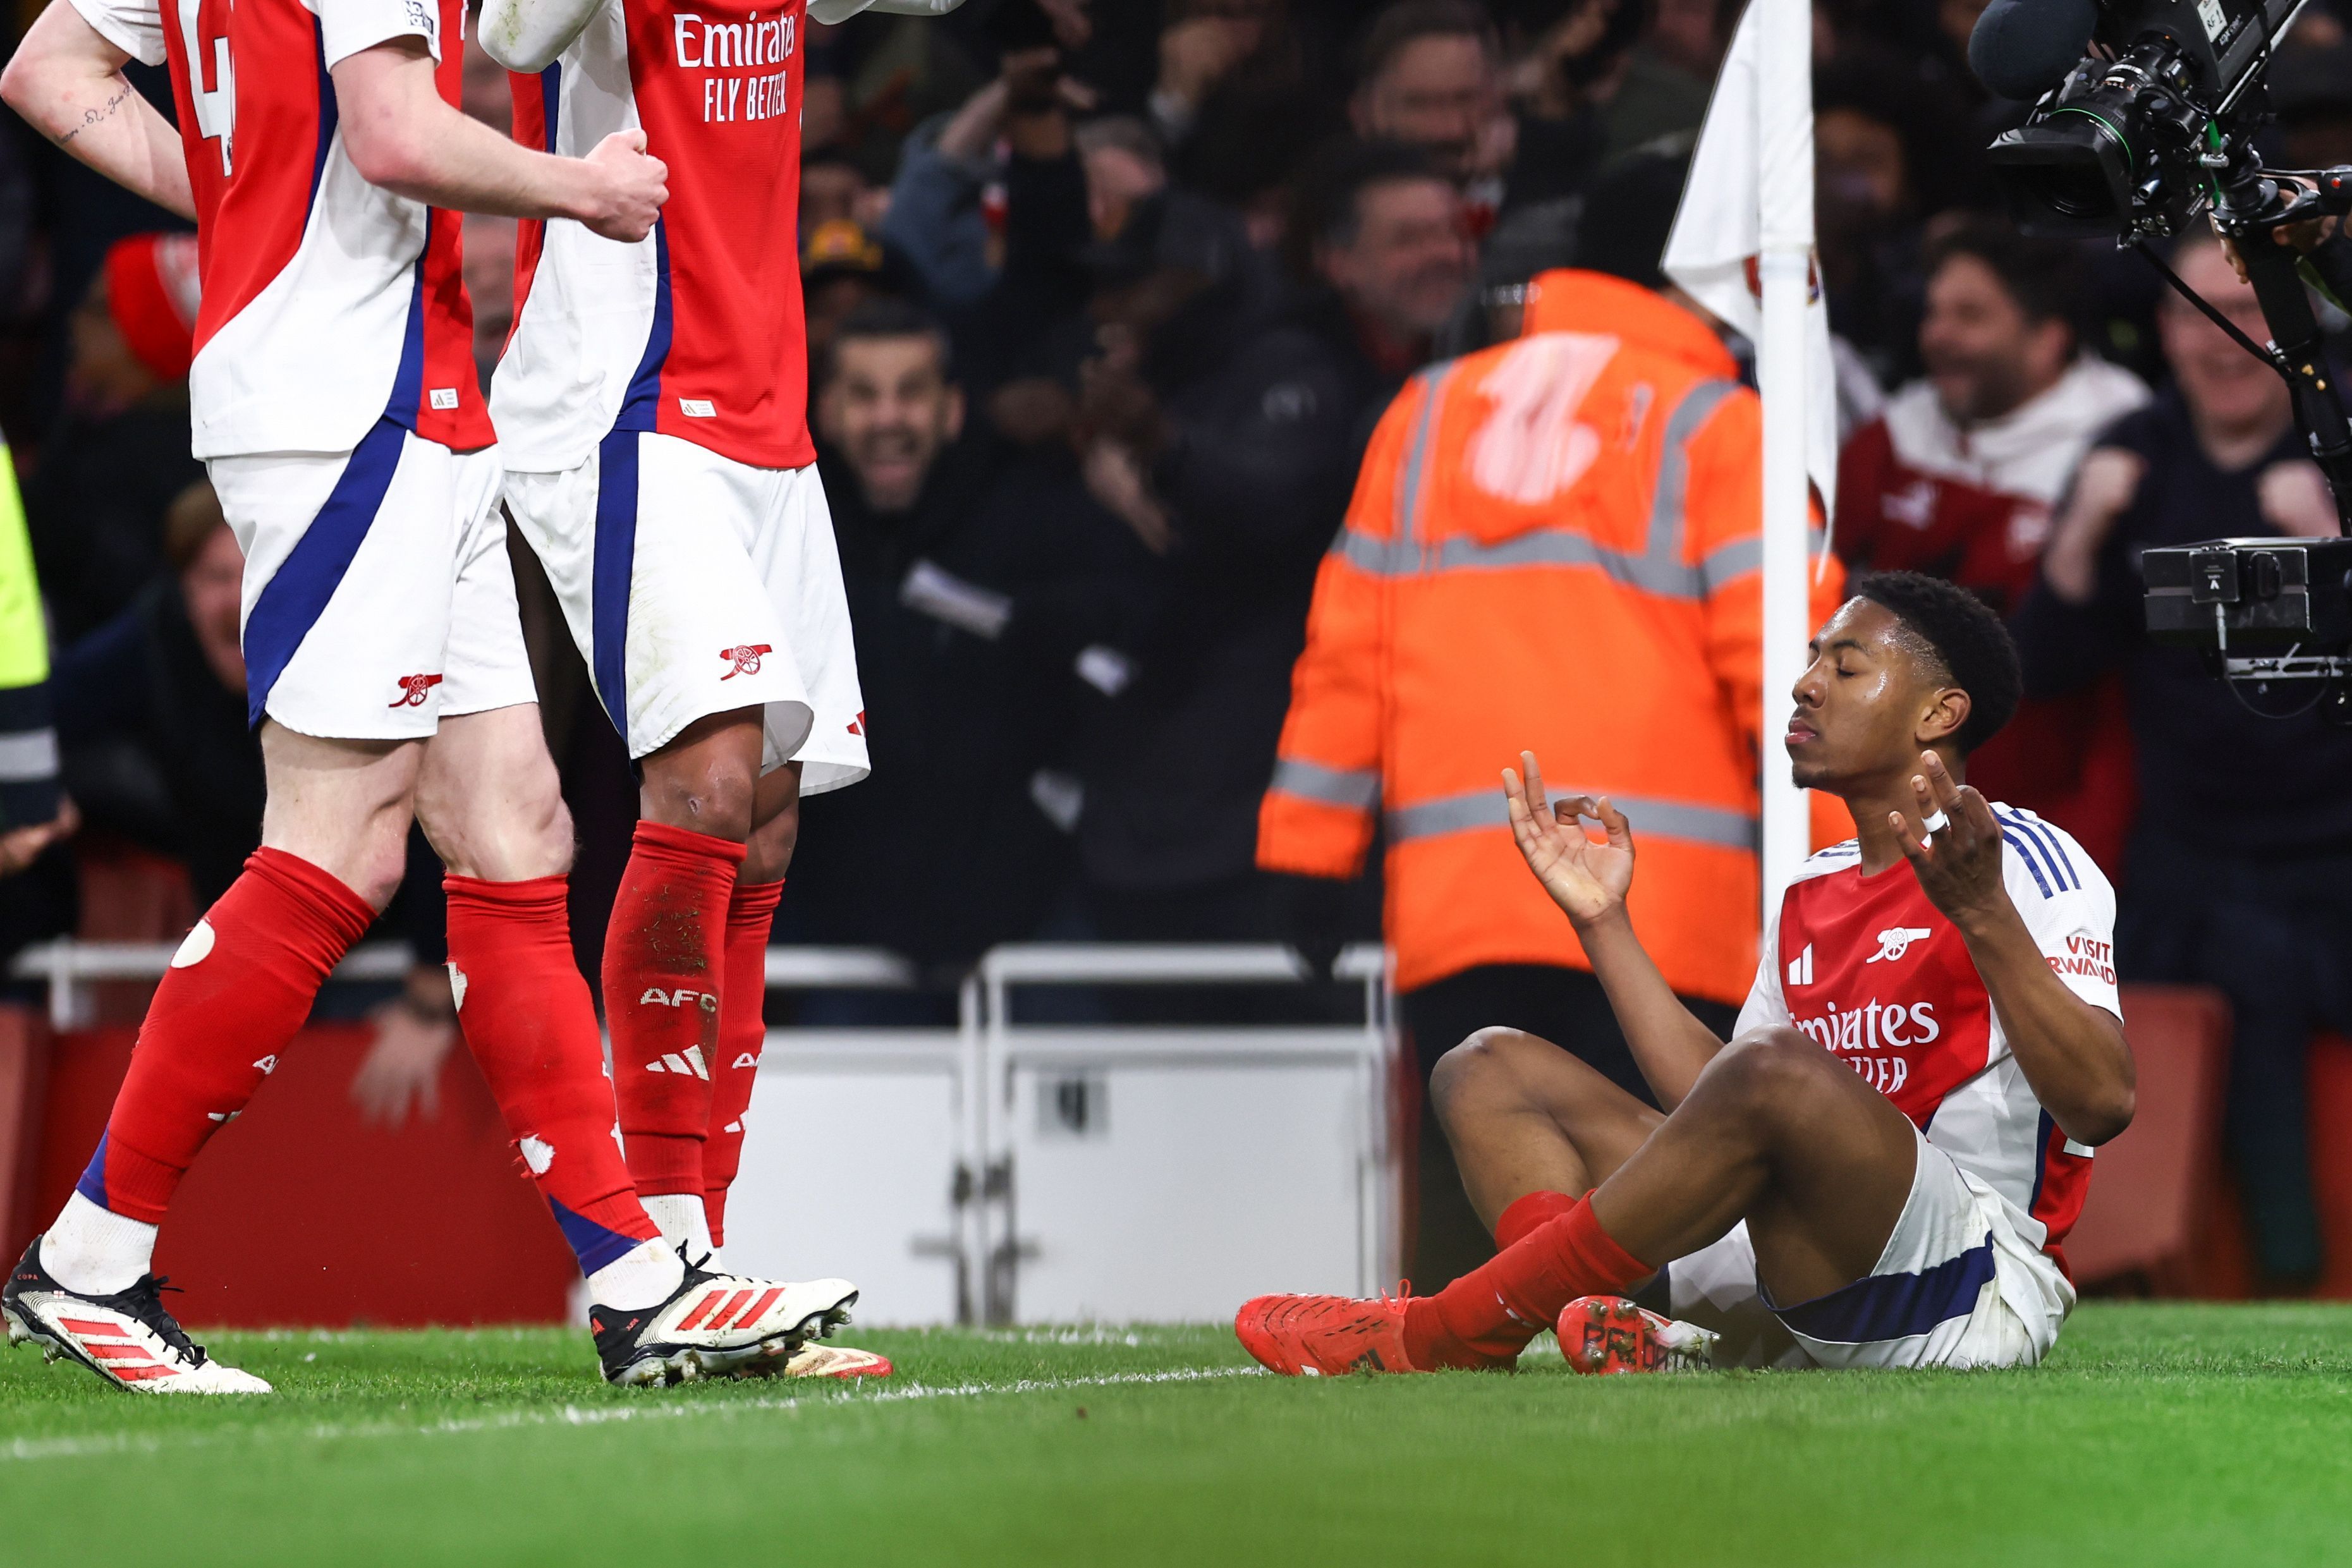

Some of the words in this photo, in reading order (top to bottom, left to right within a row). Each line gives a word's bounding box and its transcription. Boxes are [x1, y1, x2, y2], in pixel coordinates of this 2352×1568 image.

[673, 10, 798, 68] Emirate
[704, 78, 741, 122] FLY
[746, 70, 786, 121] BETTER
[2066, 936, 2110, 963] VISIT
[640, 988, 717, 1012] AFC
[1789, 997, 1940, 1050] mirates
